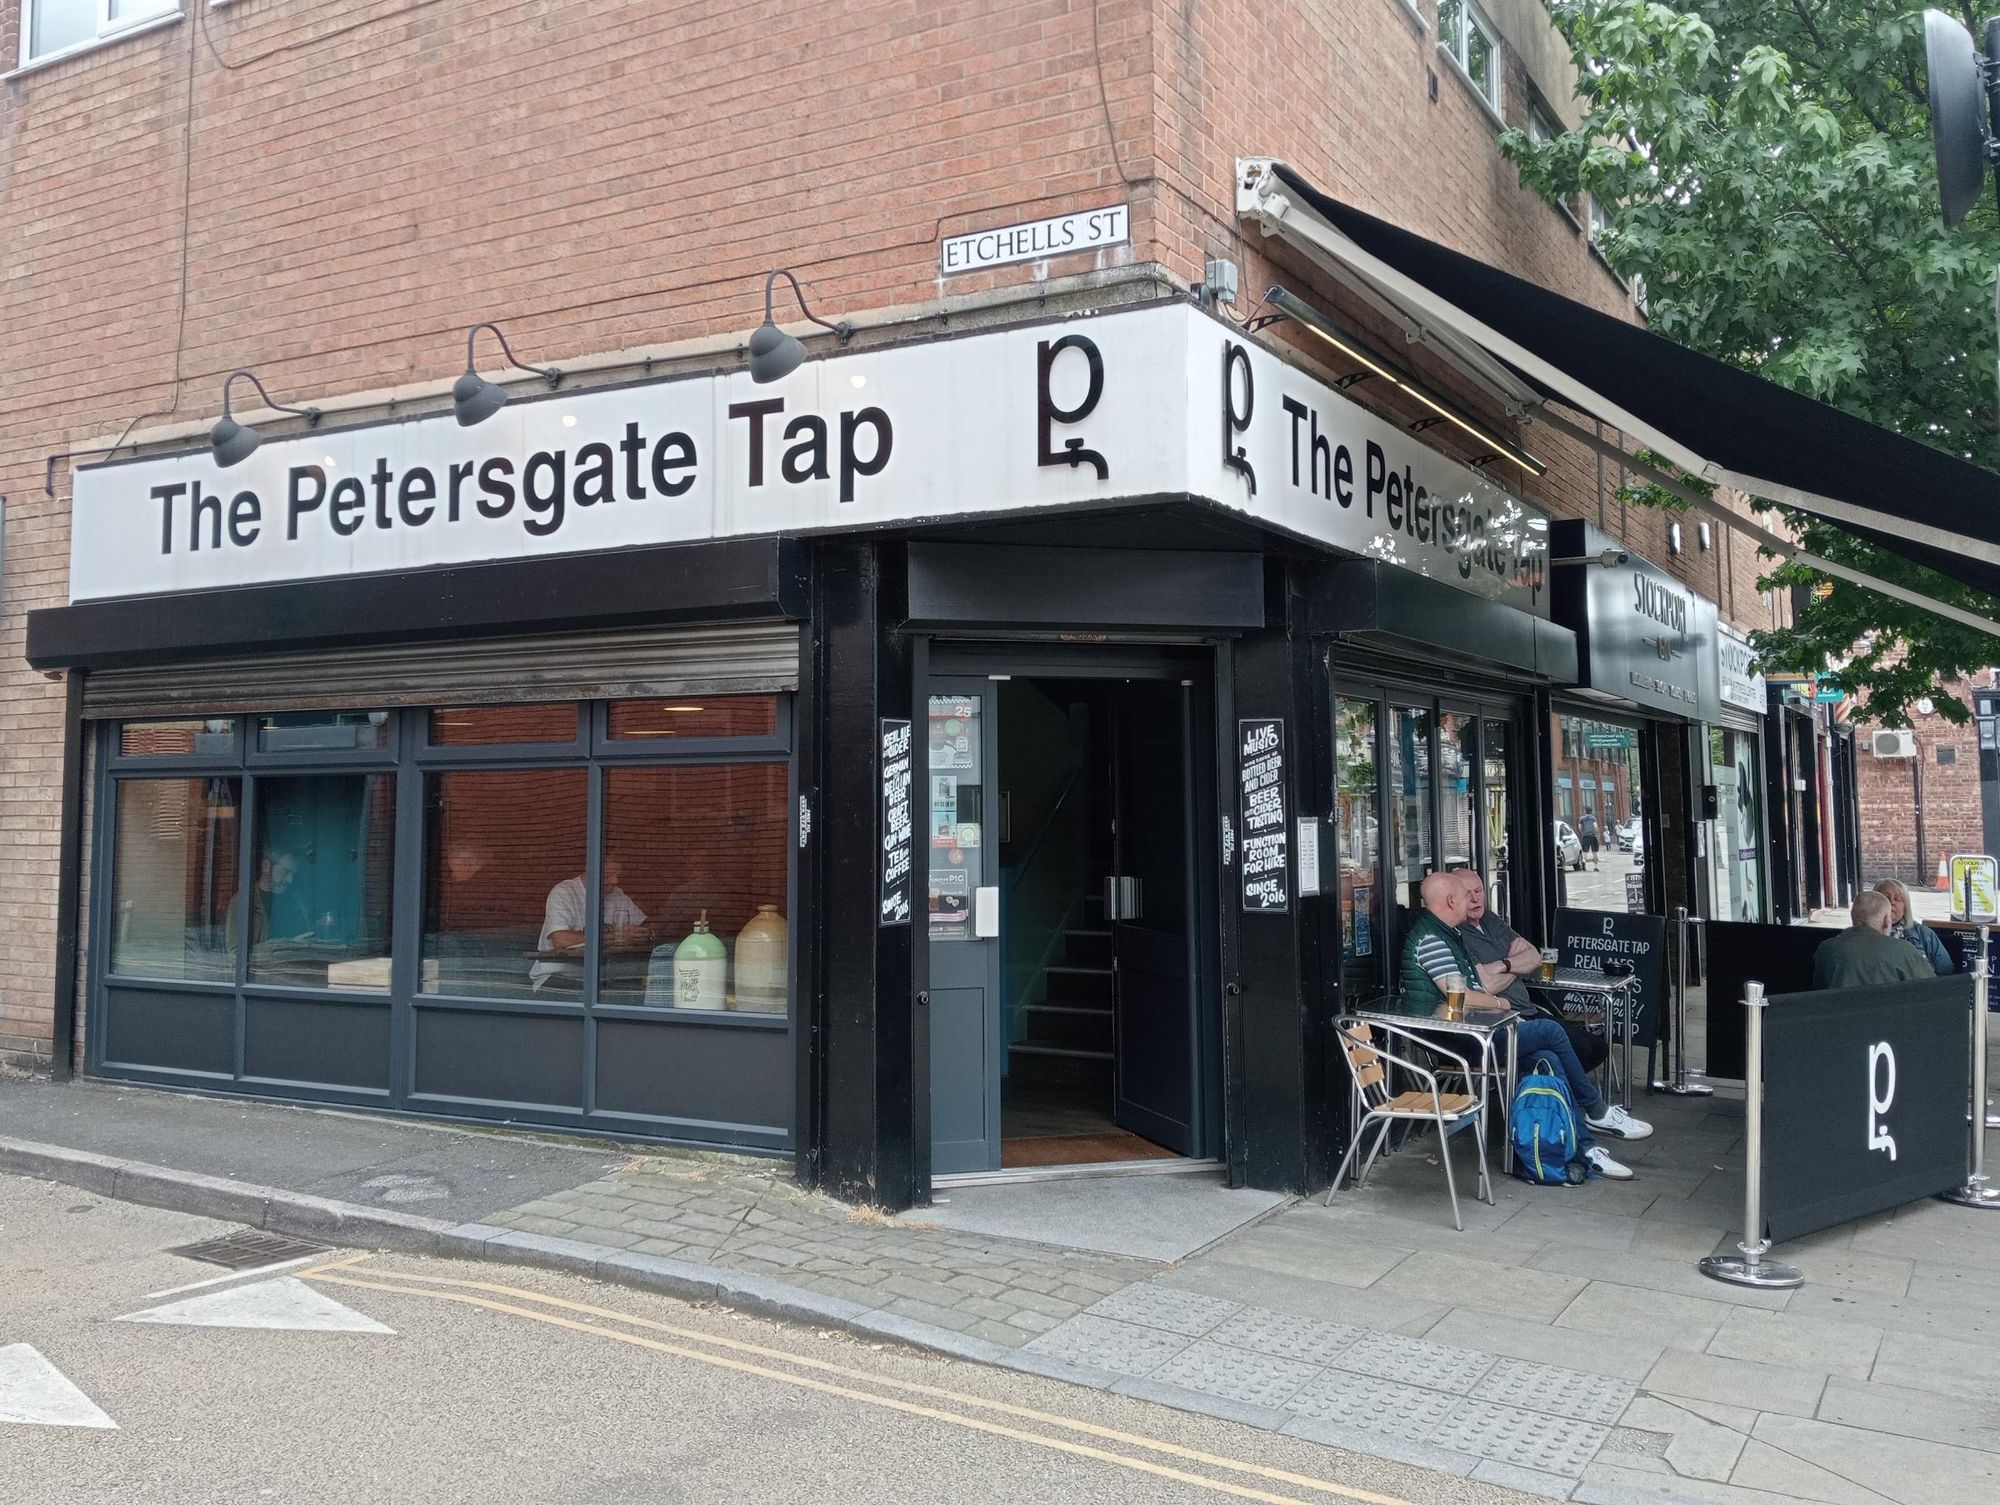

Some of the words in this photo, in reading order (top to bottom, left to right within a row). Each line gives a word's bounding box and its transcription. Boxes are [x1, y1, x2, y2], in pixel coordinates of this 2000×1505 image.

[946, 219, 1075, 267] ETCHELLS
[1088, 211, 1122, 241] ST
[1282, 393, 1354, 509] The
[150, 480, 262, 555] The
[286, 421, 698, 541] Petersgate
[728, 397, 894, 503] Tap
[1634, 571, 1689, 642] STOCKPORT
[954, 705, 973, 718] 25
[1243, 733, 1279, 756] MUSIC
[1247, 724, 1275, 744] LIVE
[1242, 761, 1267, 782] BOTTLED
[1266, 755, 1282, 771] BEER
[1244, 778, 1259, 794] AND
[1259, 769, 1279, 787] CIDER
[1249, 787, 1279, 807] BEER
[1253, 798, 1282, 816] CIDER
[890, 812, 909, 833] BEER
[1246, 809, 1283, 830] TASTING
[1243, 832, 1286, 852] FUNCTION
[1248, 844, 1279, 862] ROOM
[885, 857, 910, 883] COFFEE
[1243, 859, 1264, 876] FOR
[1264, 854, 1286, 871] HIRE
[1246, 879, 1278, 897] SINCE
[1260, 888, 1286, 908] 2016
[882, 890, 902, 914] SINCE
[1567, 935, 1630, 953] PETERSGATE
[1631, 940, 1650, 954] TAP
[1574, 953, 1604, 971] REAL
